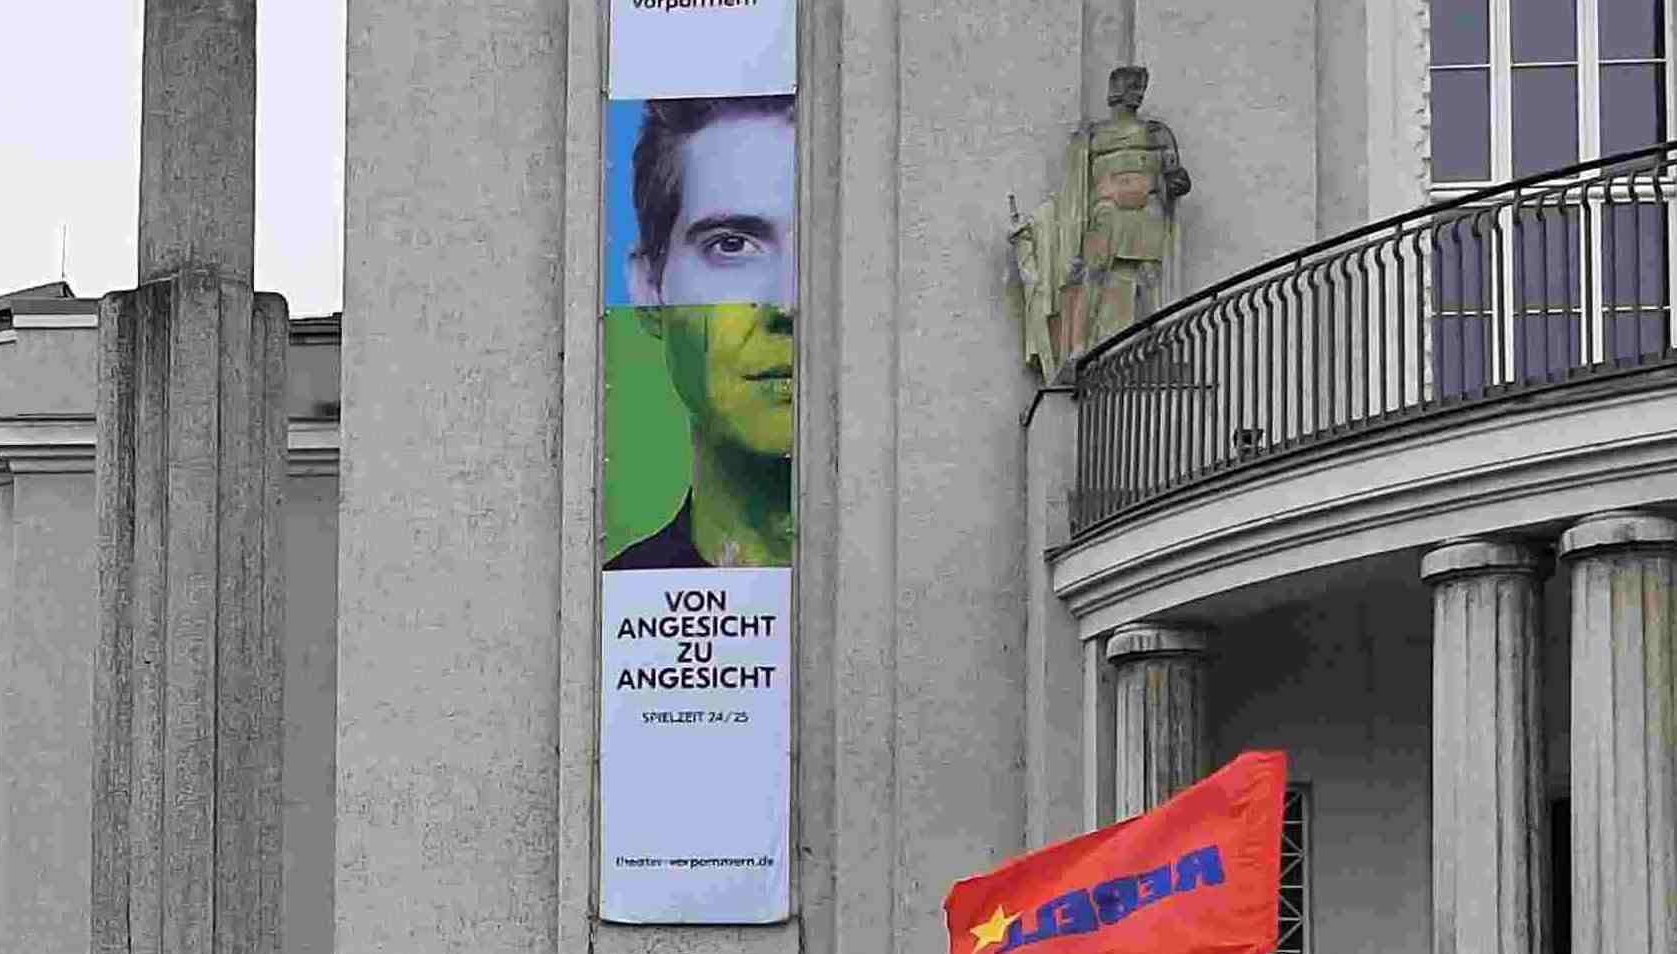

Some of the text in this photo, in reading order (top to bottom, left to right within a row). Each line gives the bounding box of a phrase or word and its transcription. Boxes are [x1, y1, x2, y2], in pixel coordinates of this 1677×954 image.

[664, 590, 727, 613] VON
[617, 615, 776, 639] ANGESICHT
[677, 641, 713, 664] ZU
[617, 666, 776, 690] ANGESICHT
[642, 711, 705, 723] SPIELZEIT
